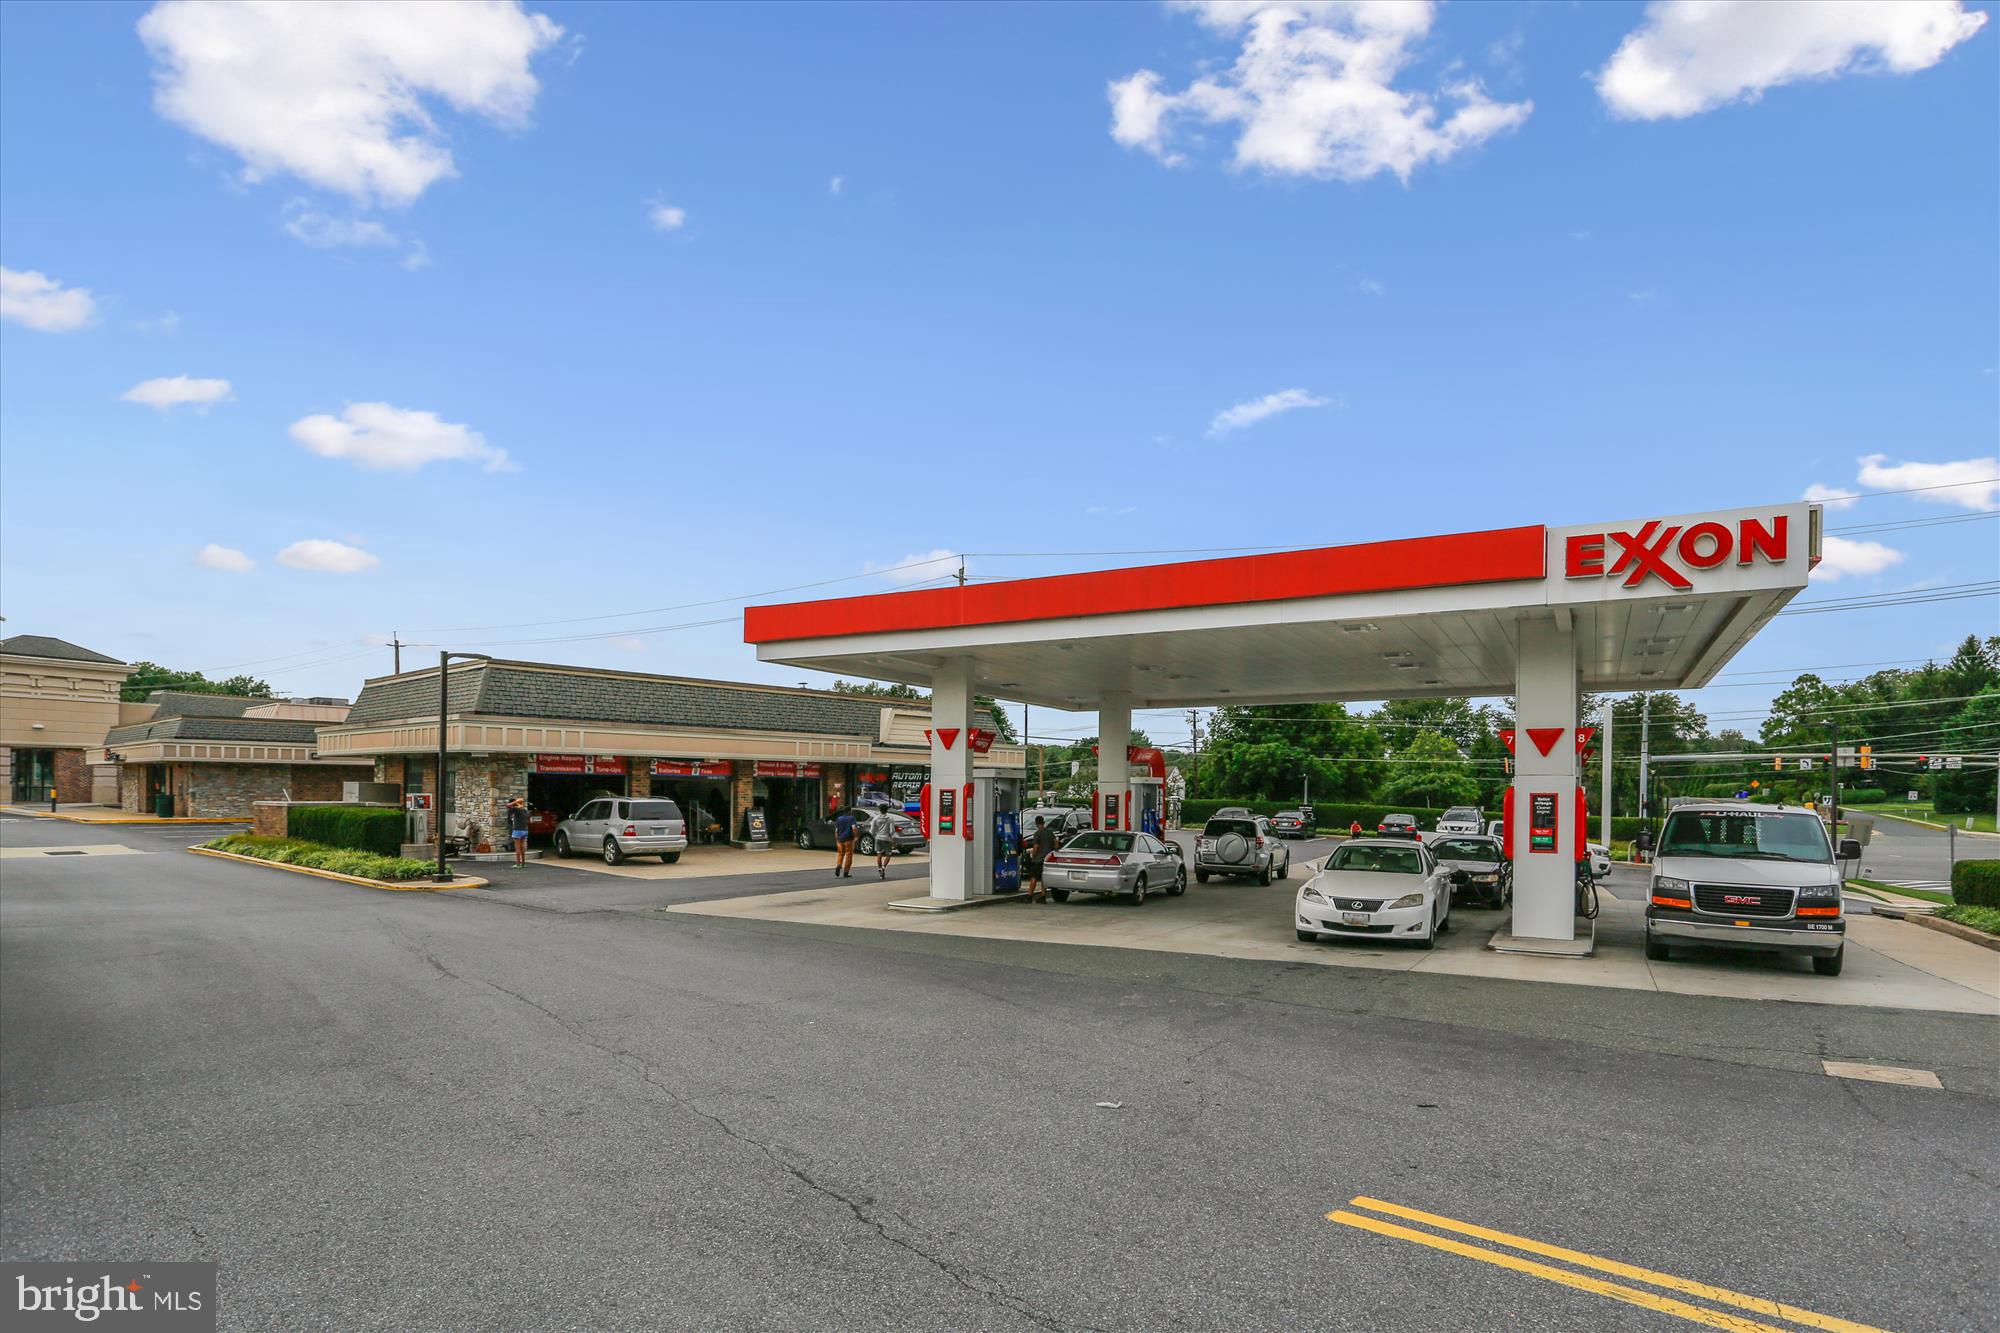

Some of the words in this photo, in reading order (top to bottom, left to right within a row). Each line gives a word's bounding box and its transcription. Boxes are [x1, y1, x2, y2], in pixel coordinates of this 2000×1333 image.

[1565, 516, 1789, 590] EXXON
[1506, 736, 1514, 745] 7
[1578, 734, 1585, 743] 8
[892, 772, 931, 780] AUTOMO
[892, 781, 921, 789] REPAIR
[1724, 895, 1761, 905] GMC
